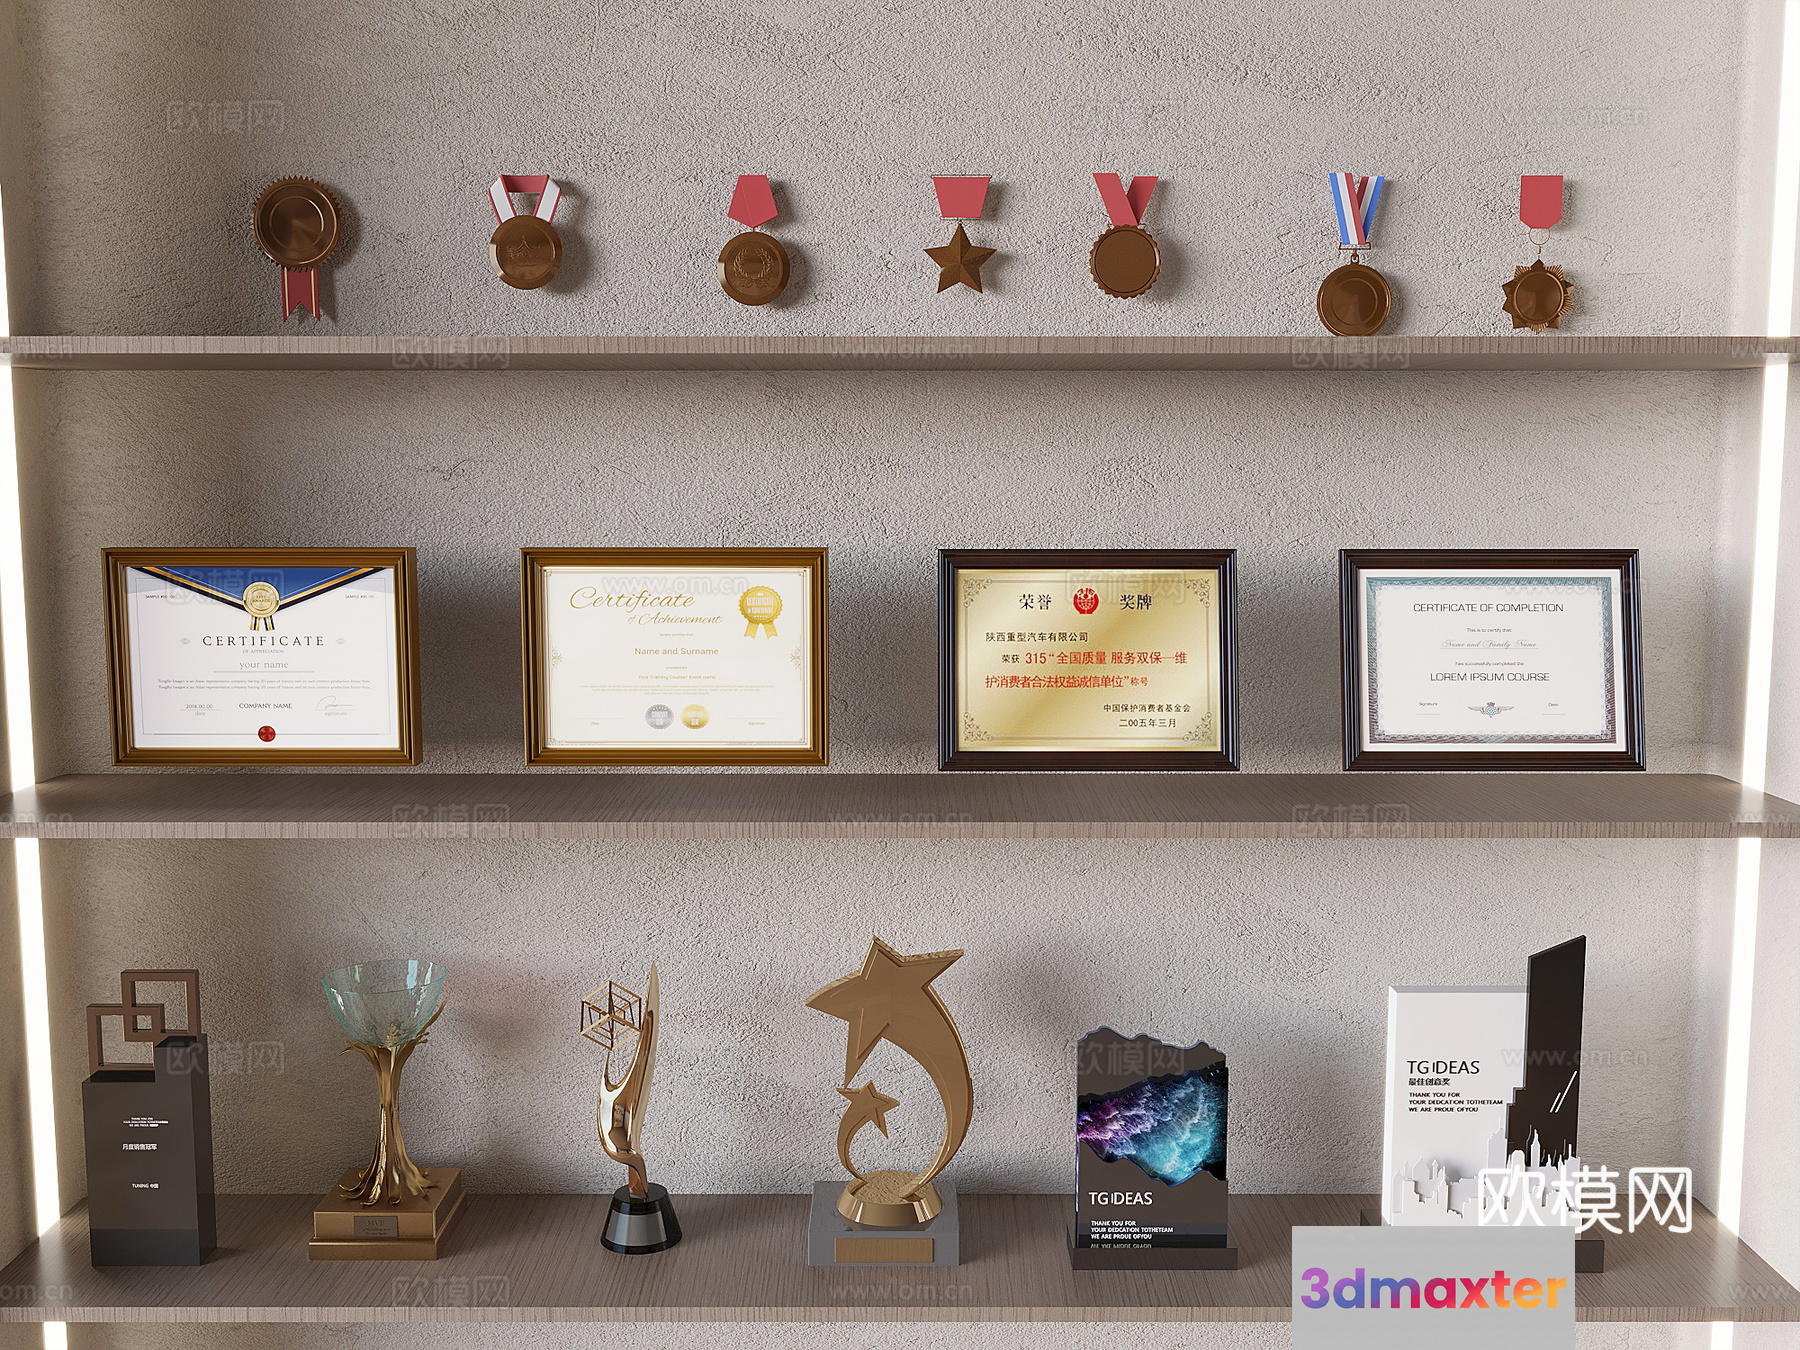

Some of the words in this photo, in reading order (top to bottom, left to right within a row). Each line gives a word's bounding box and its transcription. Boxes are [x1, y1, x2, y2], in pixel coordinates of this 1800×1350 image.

[570, 586, 695, 613] Certificate
[1019, 594, 1052, 611] 荣誉
[1119, 594, 1153, 611] 奖牌
[1413, 604, 1477, 612] CERTIFICATE
[1480, 604, 1493, 612] OF
[1496, 604, 1564, 612] COMPLETION
[628, 614, 636, 624] of
[639, 611, 723, 625] Achievement
[203, 636, 324, 646] CERTIFICATE
[985, 632, 1089, 643] 陕西重型汽车有限公司
[1442, 639, 1465, 648] Name
[1467, 640, 1481, 648] and
[1483, 639, 1511, 649] Family
[1514, 639, 1537, 648] Name
[662, 647, 678, 655] and
[1001, 654, 1020, 664] 荣获
[239, 662, 260, 671] your
[1431, 673, 1467, 681] LOREM
[1470, 673, 1505, 681] IPSUM
[1507, 673, 1550, 681] COURSE
[1103, 703, 1191, 713] 中国保护消费者基金会
[1408, 1078, 1451, 1086] 最佳创意奖
